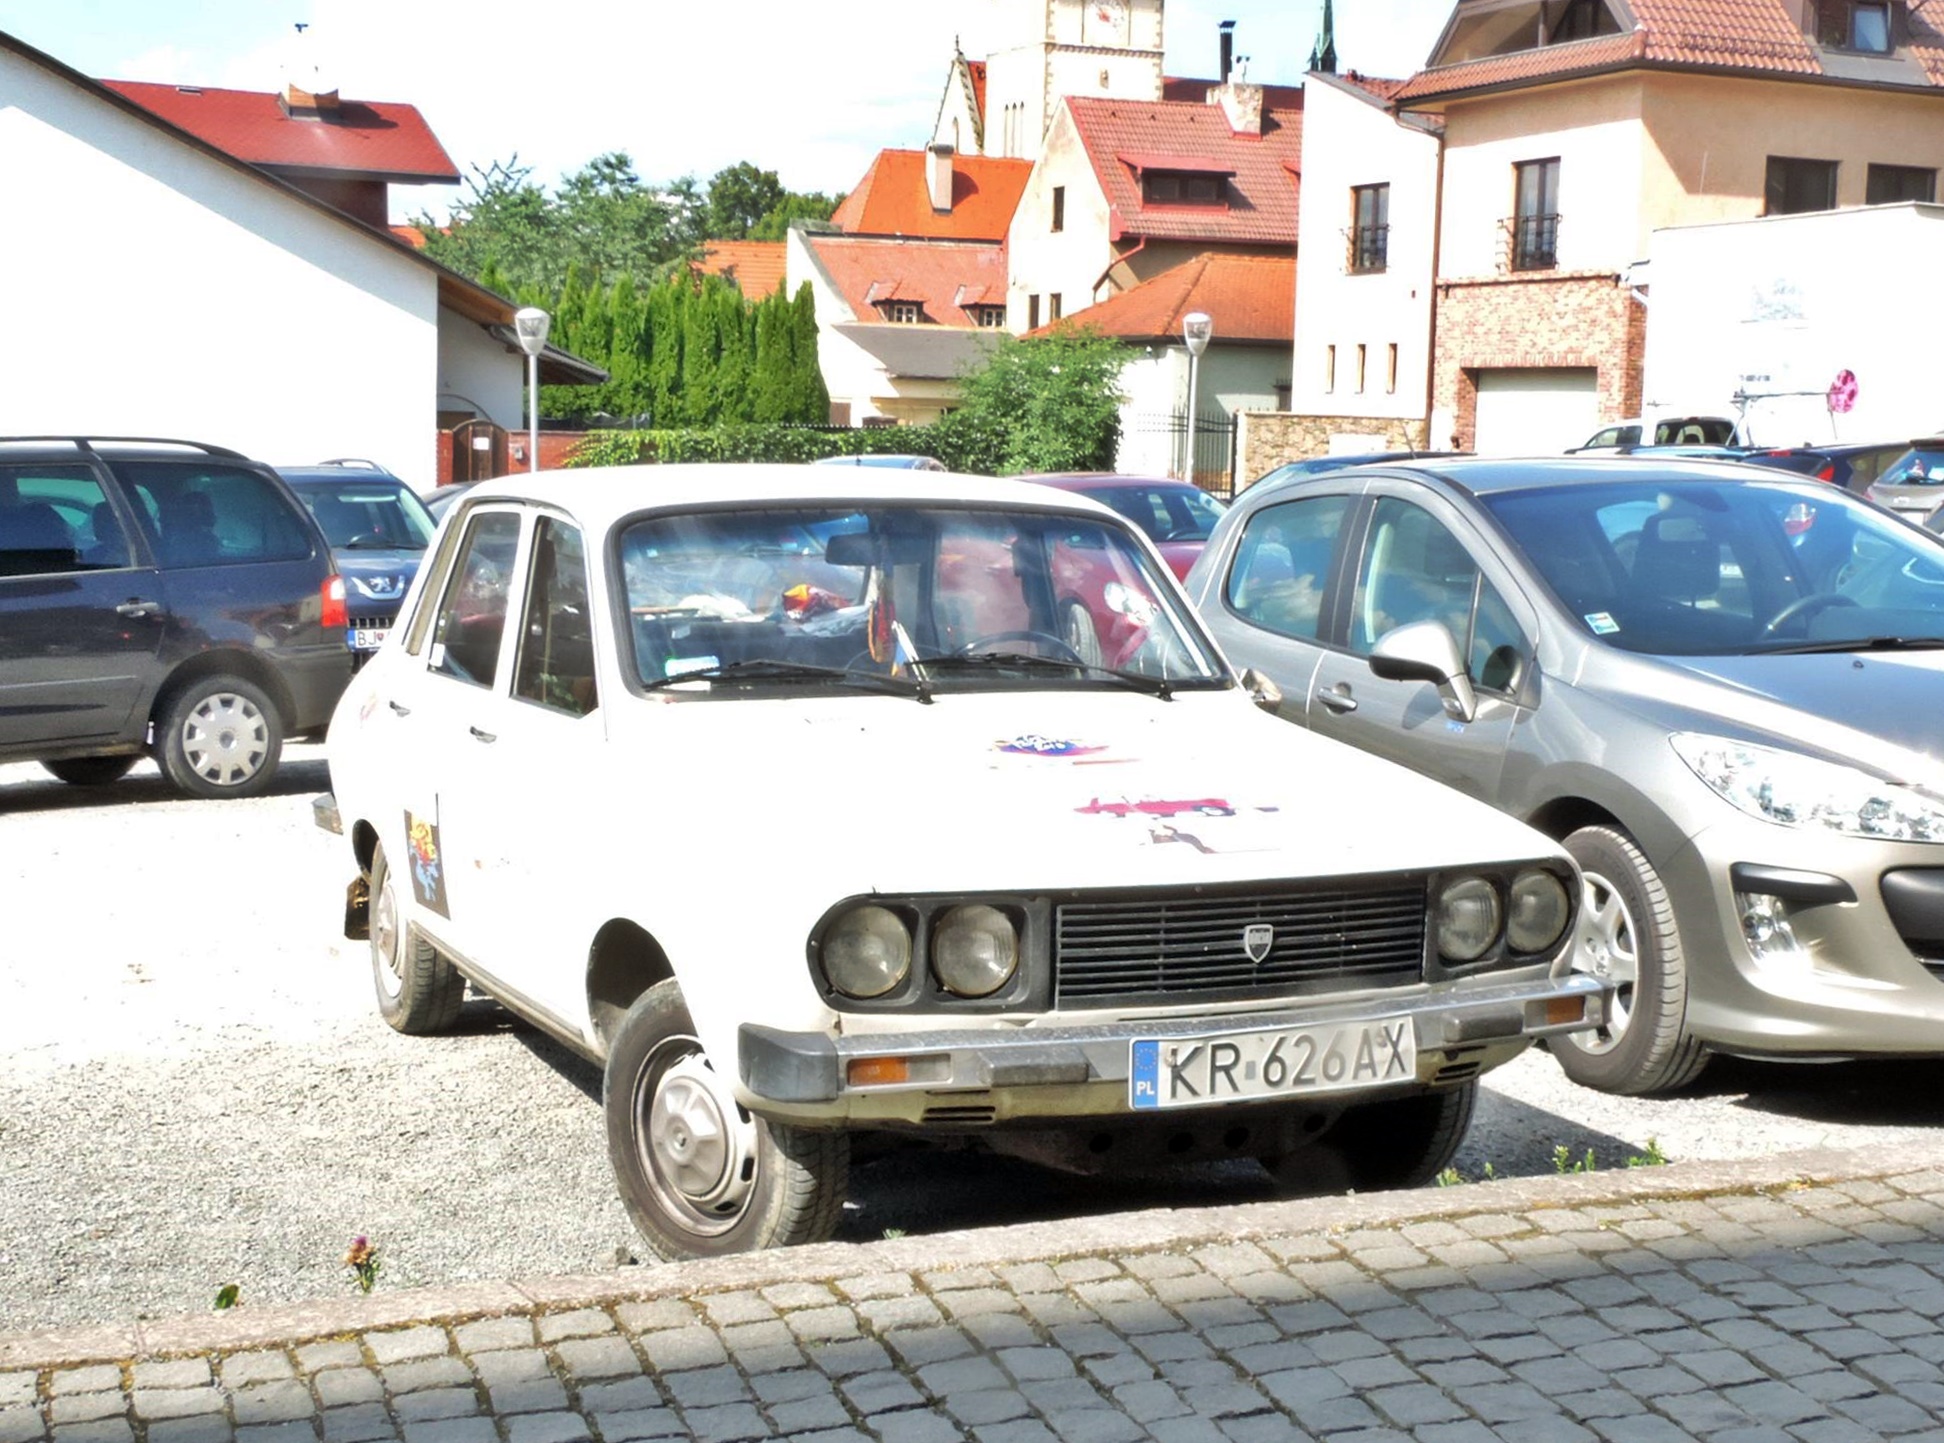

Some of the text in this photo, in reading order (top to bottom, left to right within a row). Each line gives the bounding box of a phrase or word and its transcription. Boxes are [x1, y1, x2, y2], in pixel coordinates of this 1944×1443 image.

[1169, 1022, 1407, 1099] KR 626AX
[1136, 1080, 1155, 1096] PL
